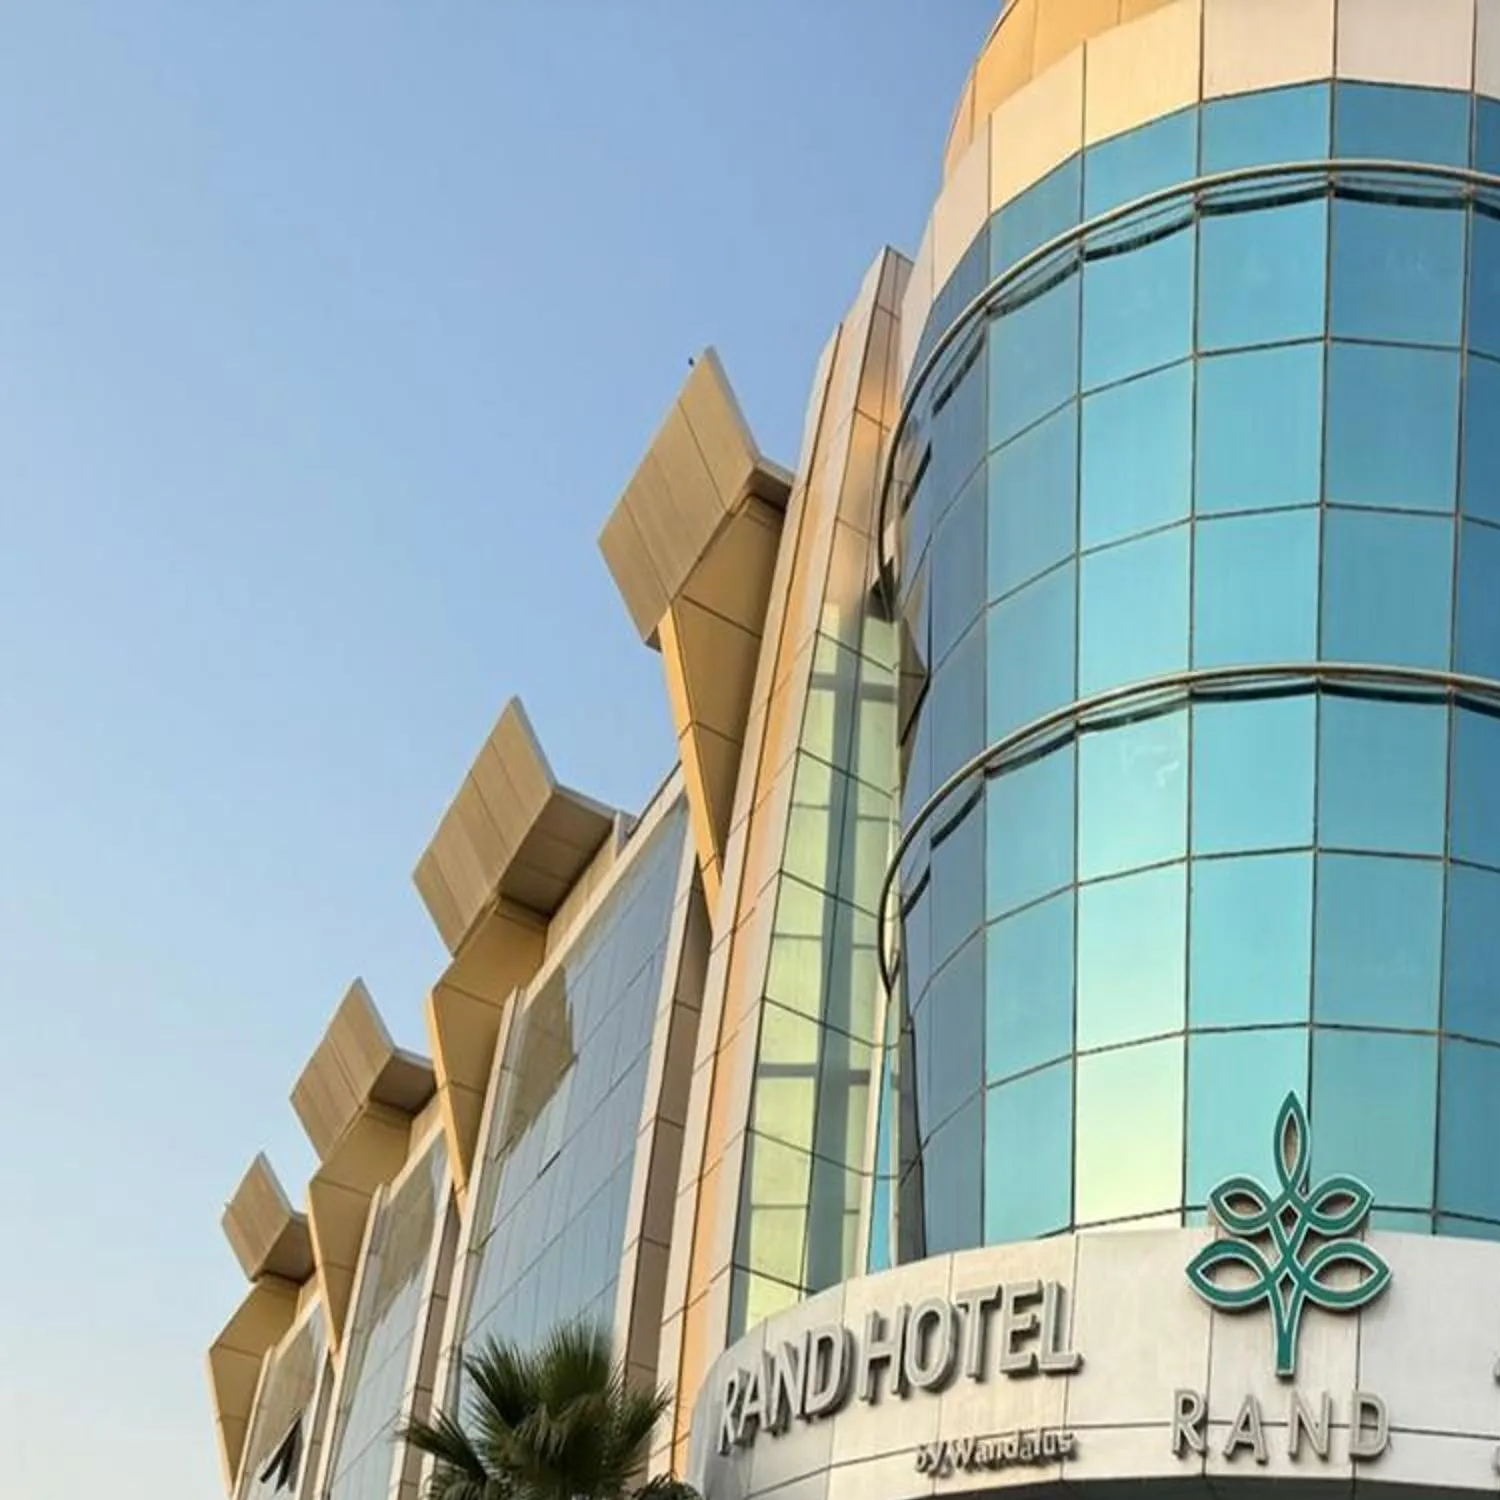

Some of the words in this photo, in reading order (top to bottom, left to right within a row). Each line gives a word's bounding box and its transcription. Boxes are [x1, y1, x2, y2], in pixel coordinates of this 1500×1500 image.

[717, 1322, 855, 1456] RAND
[857, 1278, 1083, 1404] HOTEL
[914, 1440, 952, 1478] by
[949, 1428, 1080, 1473] Wandalus
[1170, 1388, 1393, 1463] RAND
